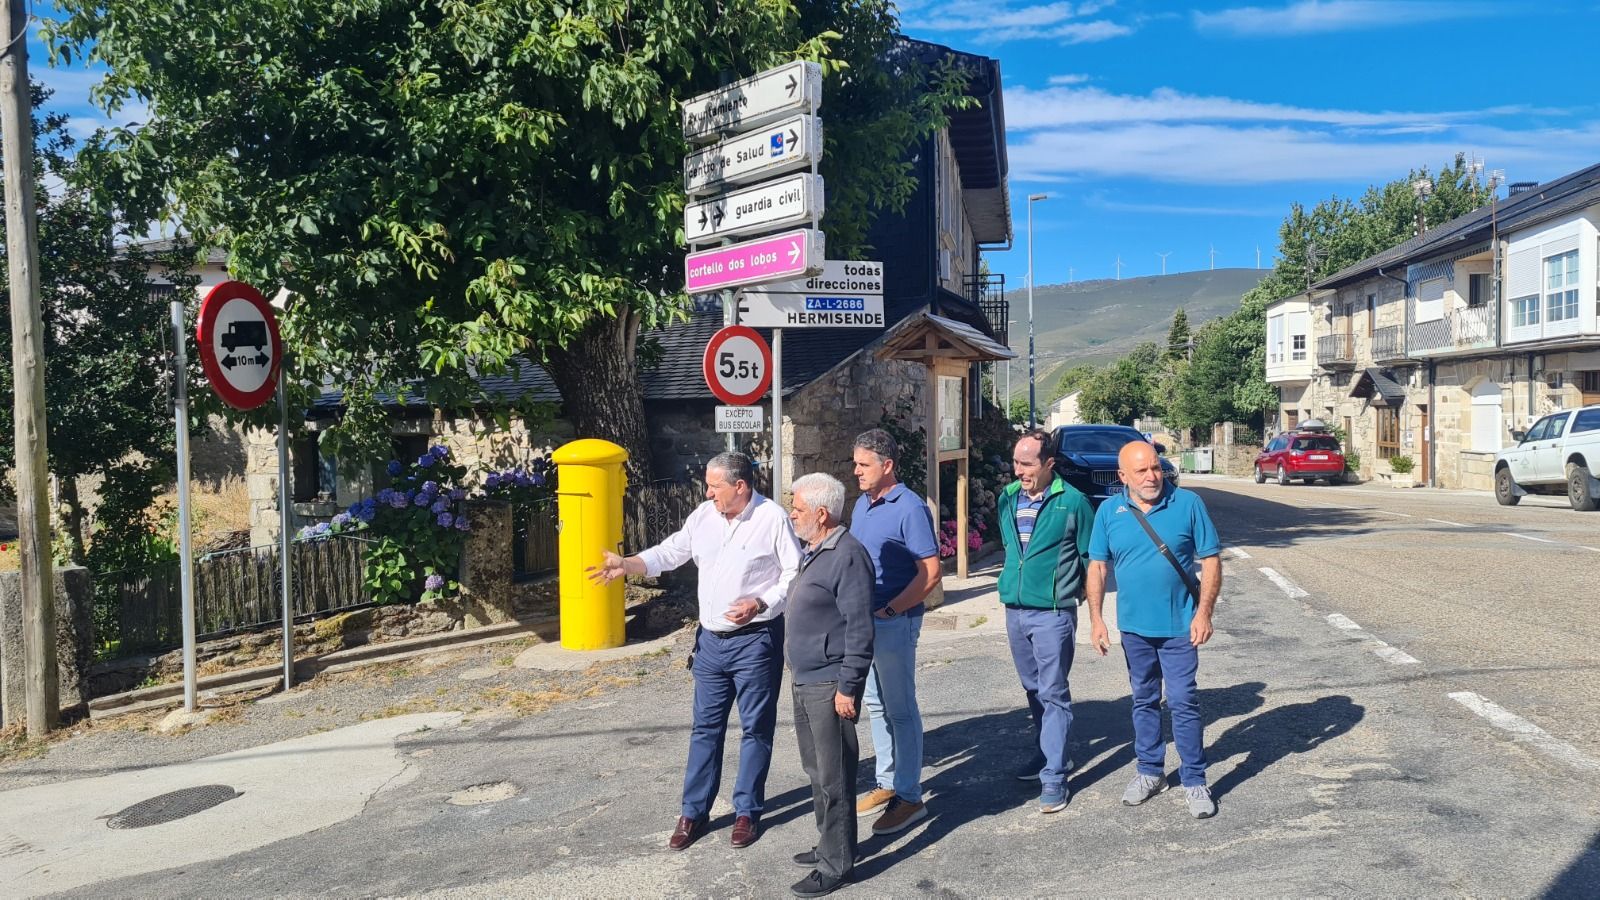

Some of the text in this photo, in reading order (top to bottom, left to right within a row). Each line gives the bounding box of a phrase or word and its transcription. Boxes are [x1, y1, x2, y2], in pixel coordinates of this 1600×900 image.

[688, 162, 715, 179] centro
[721, 155, 731, 168] de
[736, 144, 764, 164] Salud
[735, 188, 801, 219] guardia civil
[689, 252, 777, 278] cortello dos lobos
[844, 264, 881, 276] todas
[806, 278, 881, 290] direcciones
[807, 299, 863, 309] ZA-L-2686
[787, 313, 883, 325] HERMISENDE
[725, 409, 754, 418] EXCEPTO
[718, 421, 761, 430] BUS ESCOLAR
